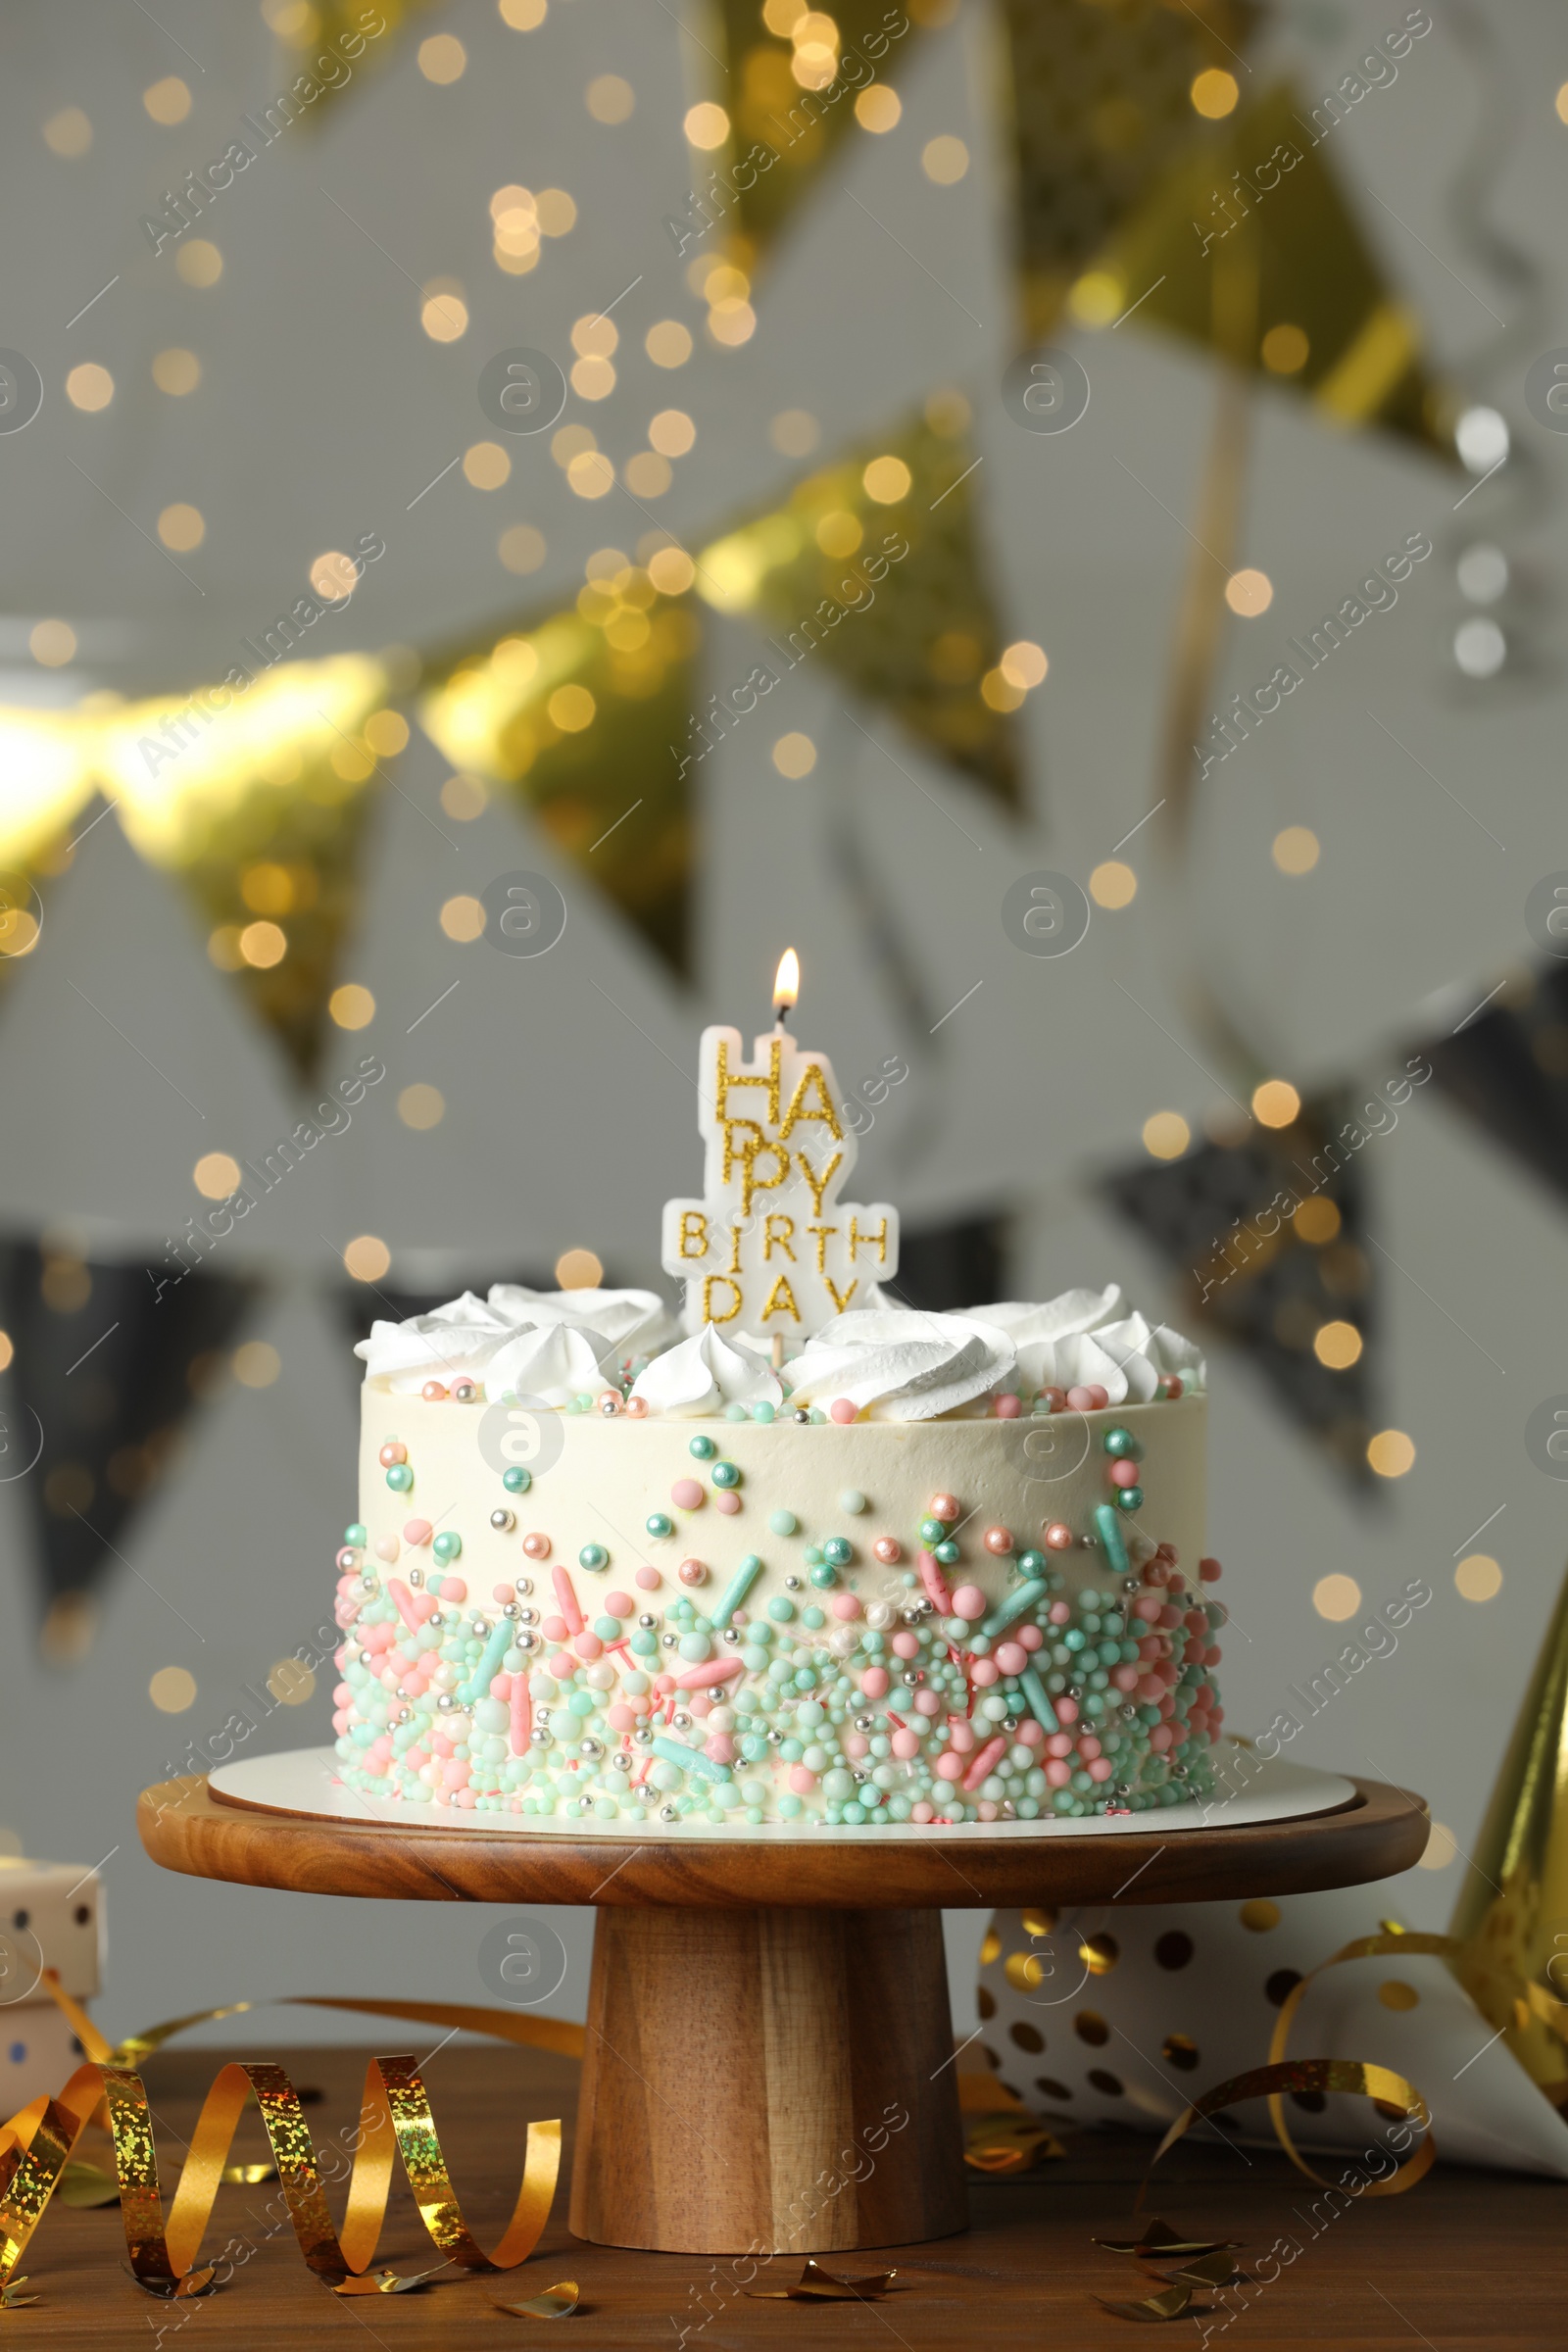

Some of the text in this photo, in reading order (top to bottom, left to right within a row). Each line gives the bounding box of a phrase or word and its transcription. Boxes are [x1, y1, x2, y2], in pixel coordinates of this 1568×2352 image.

[716, 1040, 843, 1140] HA
[721, 1117, 843, 1217] PPY
[678, 1210, 887, 1274] BIRTH
[702, 1274, 858, 1324] DAY
